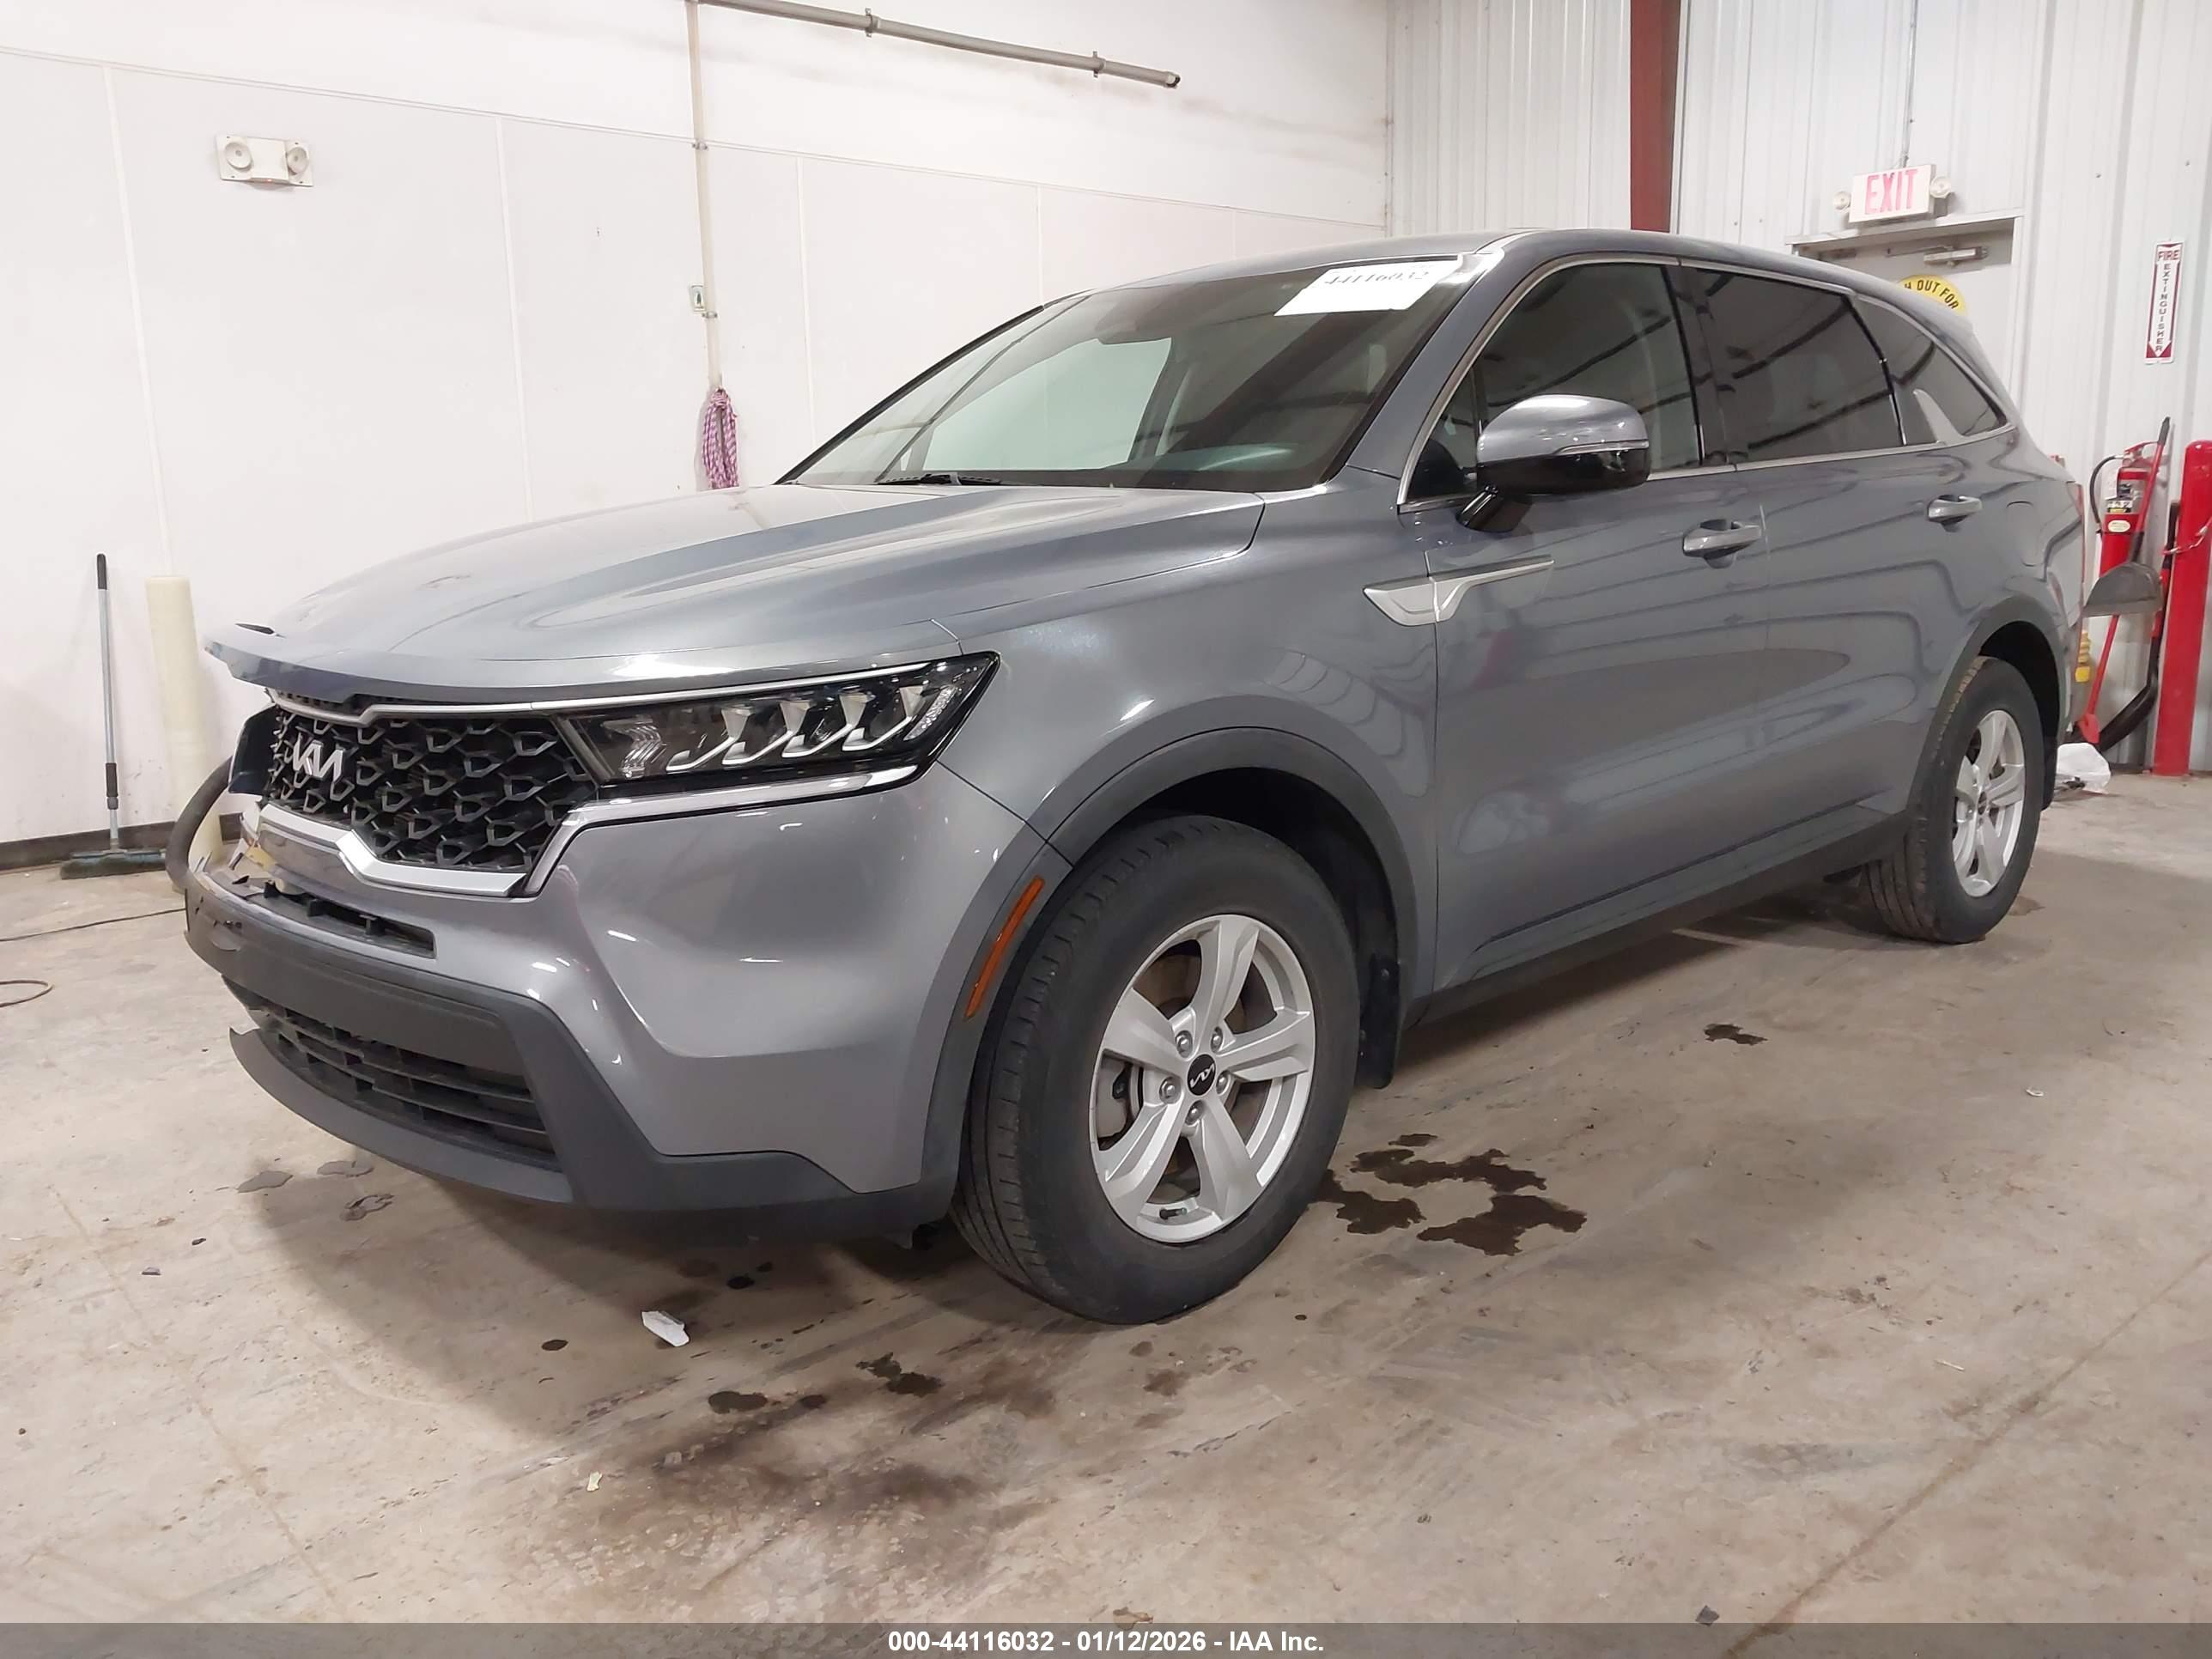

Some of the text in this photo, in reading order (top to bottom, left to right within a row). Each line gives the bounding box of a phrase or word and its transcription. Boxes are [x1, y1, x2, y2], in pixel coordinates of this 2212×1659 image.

[1864, 168, 1918, 215] EXIT
[2157, 248, 2181, 261] FIRE
[1916, 279, 1941, 294] OUT
[1939, 287, 1960, 310] FOR
[2154, 263, 2172, 352] EXTINGUISHER
